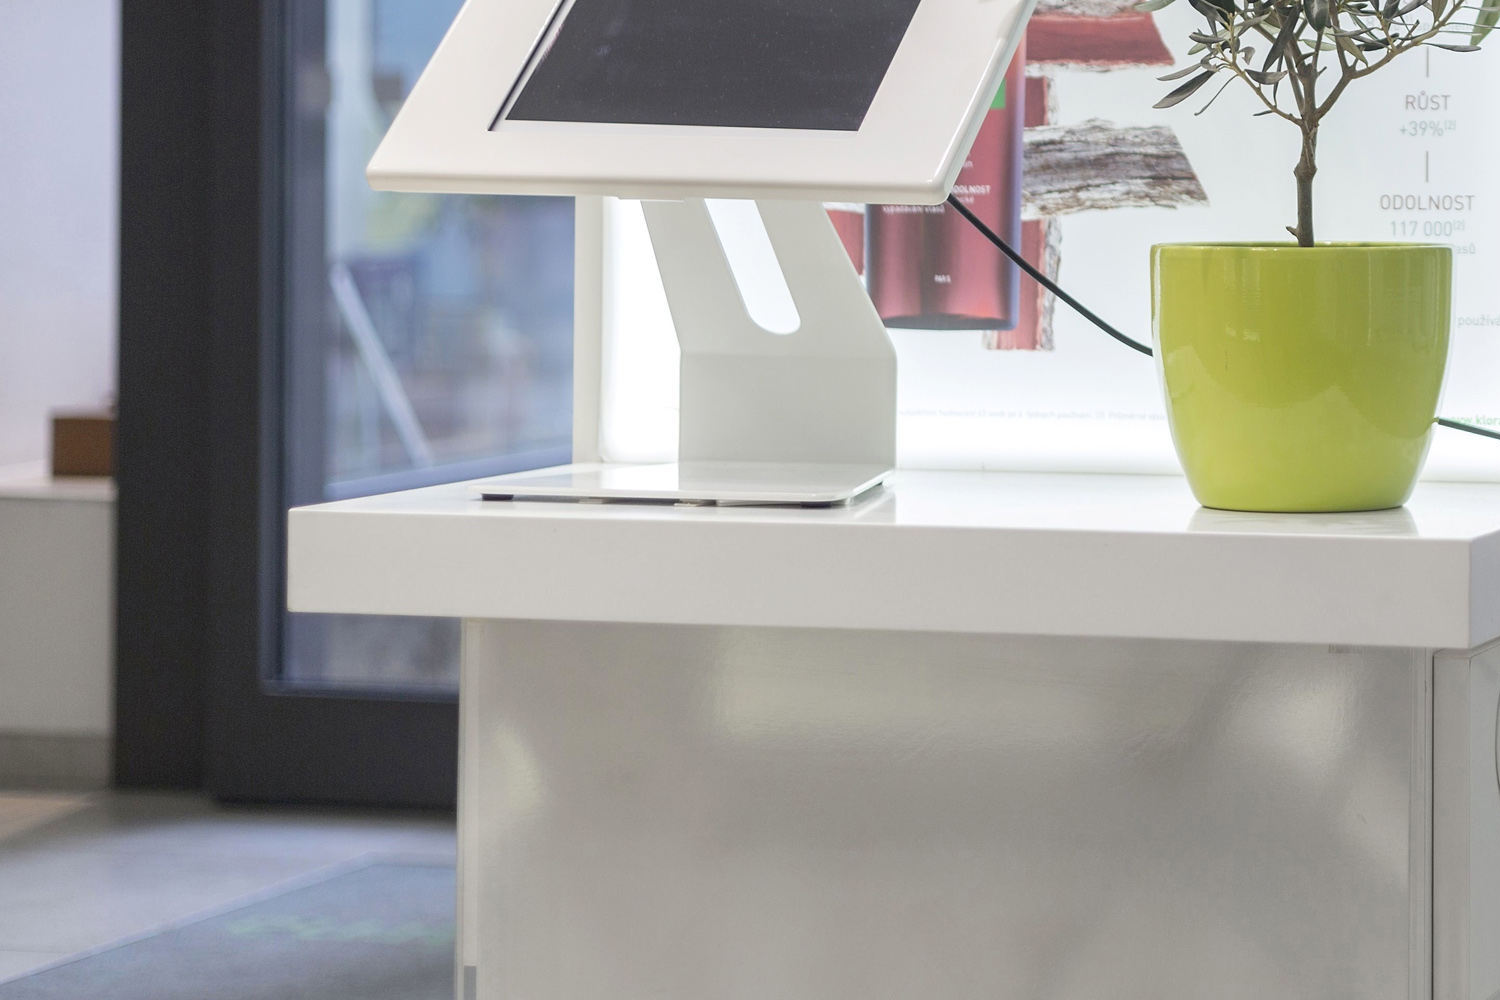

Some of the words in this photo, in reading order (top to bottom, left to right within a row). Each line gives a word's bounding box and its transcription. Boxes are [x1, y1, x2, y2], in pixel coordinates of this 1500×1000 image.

[1404, 90, 1451, 111] RŮST
[1379, 194, 1475, 211] ODOLNOST
[1390, 220, 1418, 237] 117
[1455, 242, 1477, 255] asů
